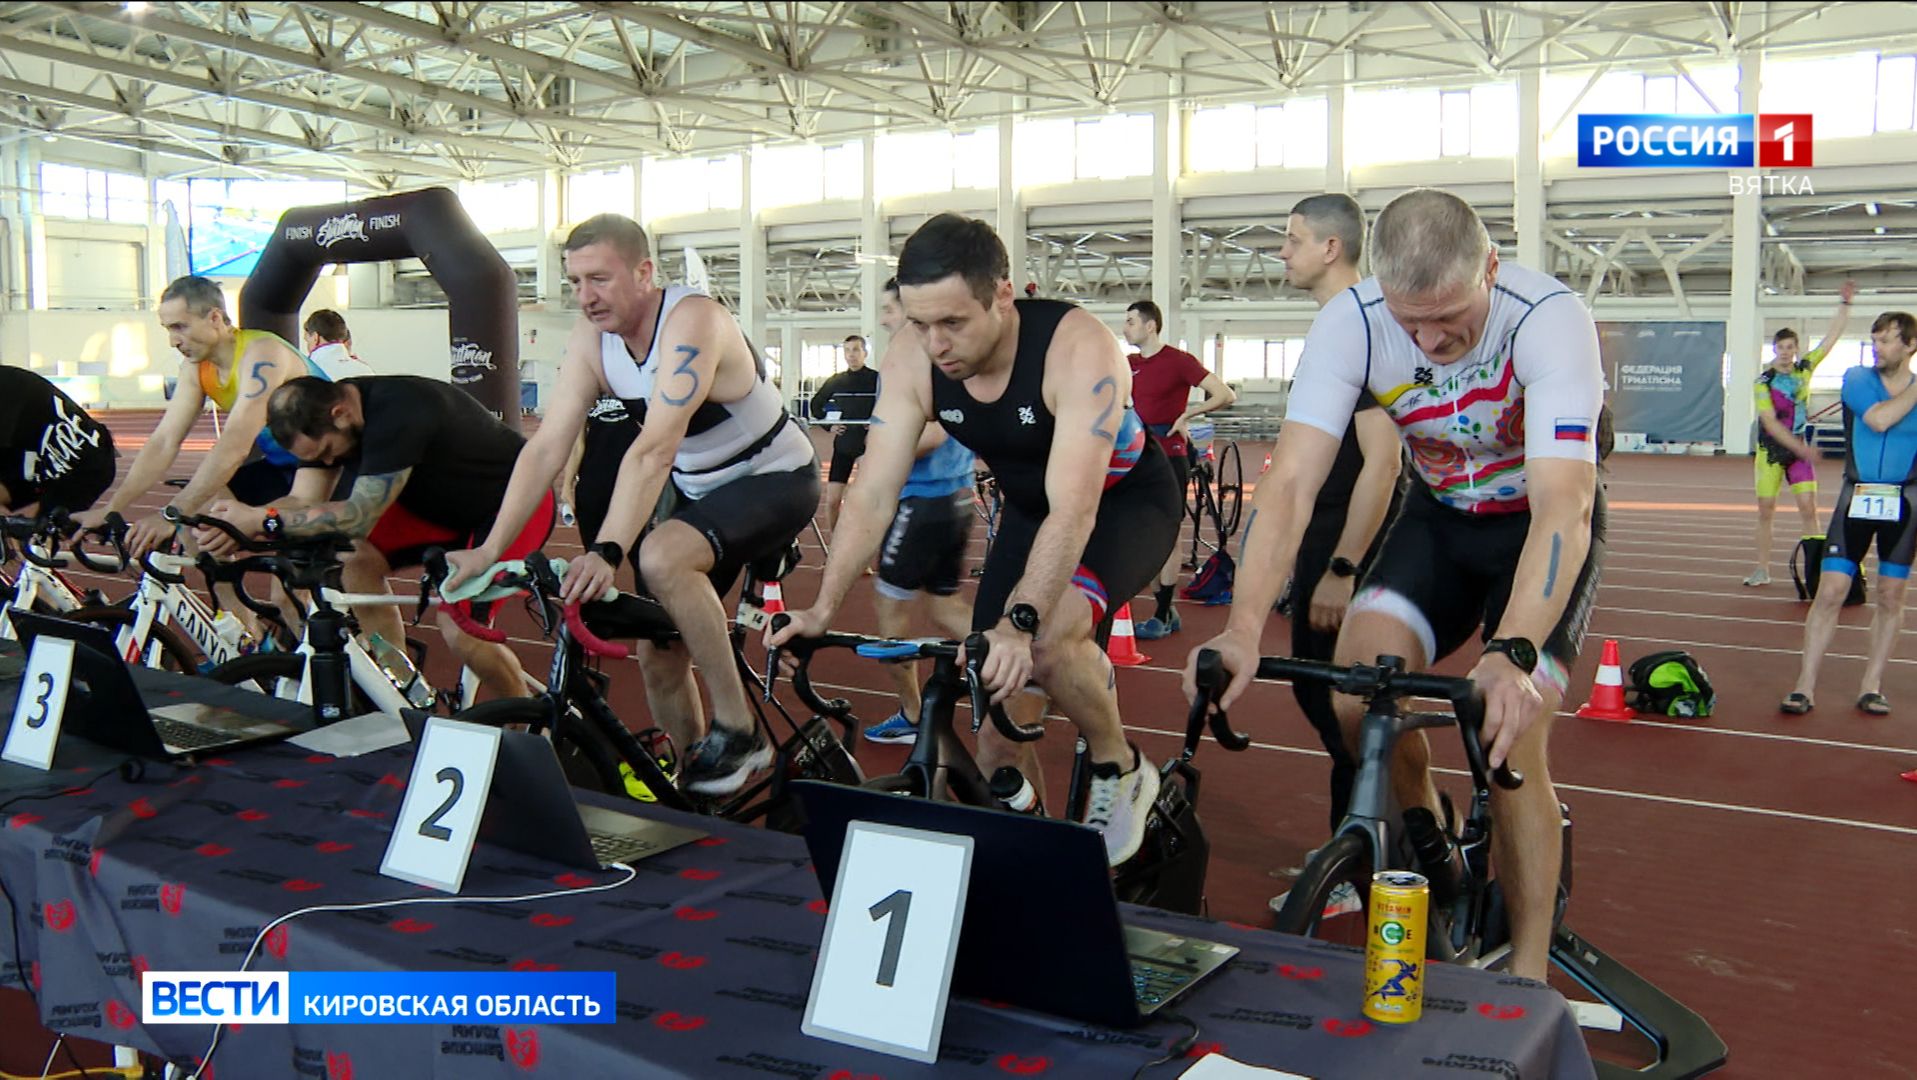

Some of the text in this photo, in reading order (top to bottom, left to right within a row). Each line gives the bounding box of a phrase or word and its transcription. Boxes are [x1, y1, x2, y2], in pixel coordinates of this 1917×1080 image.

[285, 226, 313, 240] FINISH
[369, 213, 401, 230] FINISH
[244, 360, 278, 399] 5
[661, 344, 700, 407] 3
[1621, 364, 1683, 375] ФЕДЕРАЦИЯ
[1621, 375, 1682, 385] ТРИАТЛОНА
[1090, 375, 1117, 446] 2
[26, 672, 55, 730] 3
[417, 766, 465, 842] 2
[868, 888, 913, 988] 1
